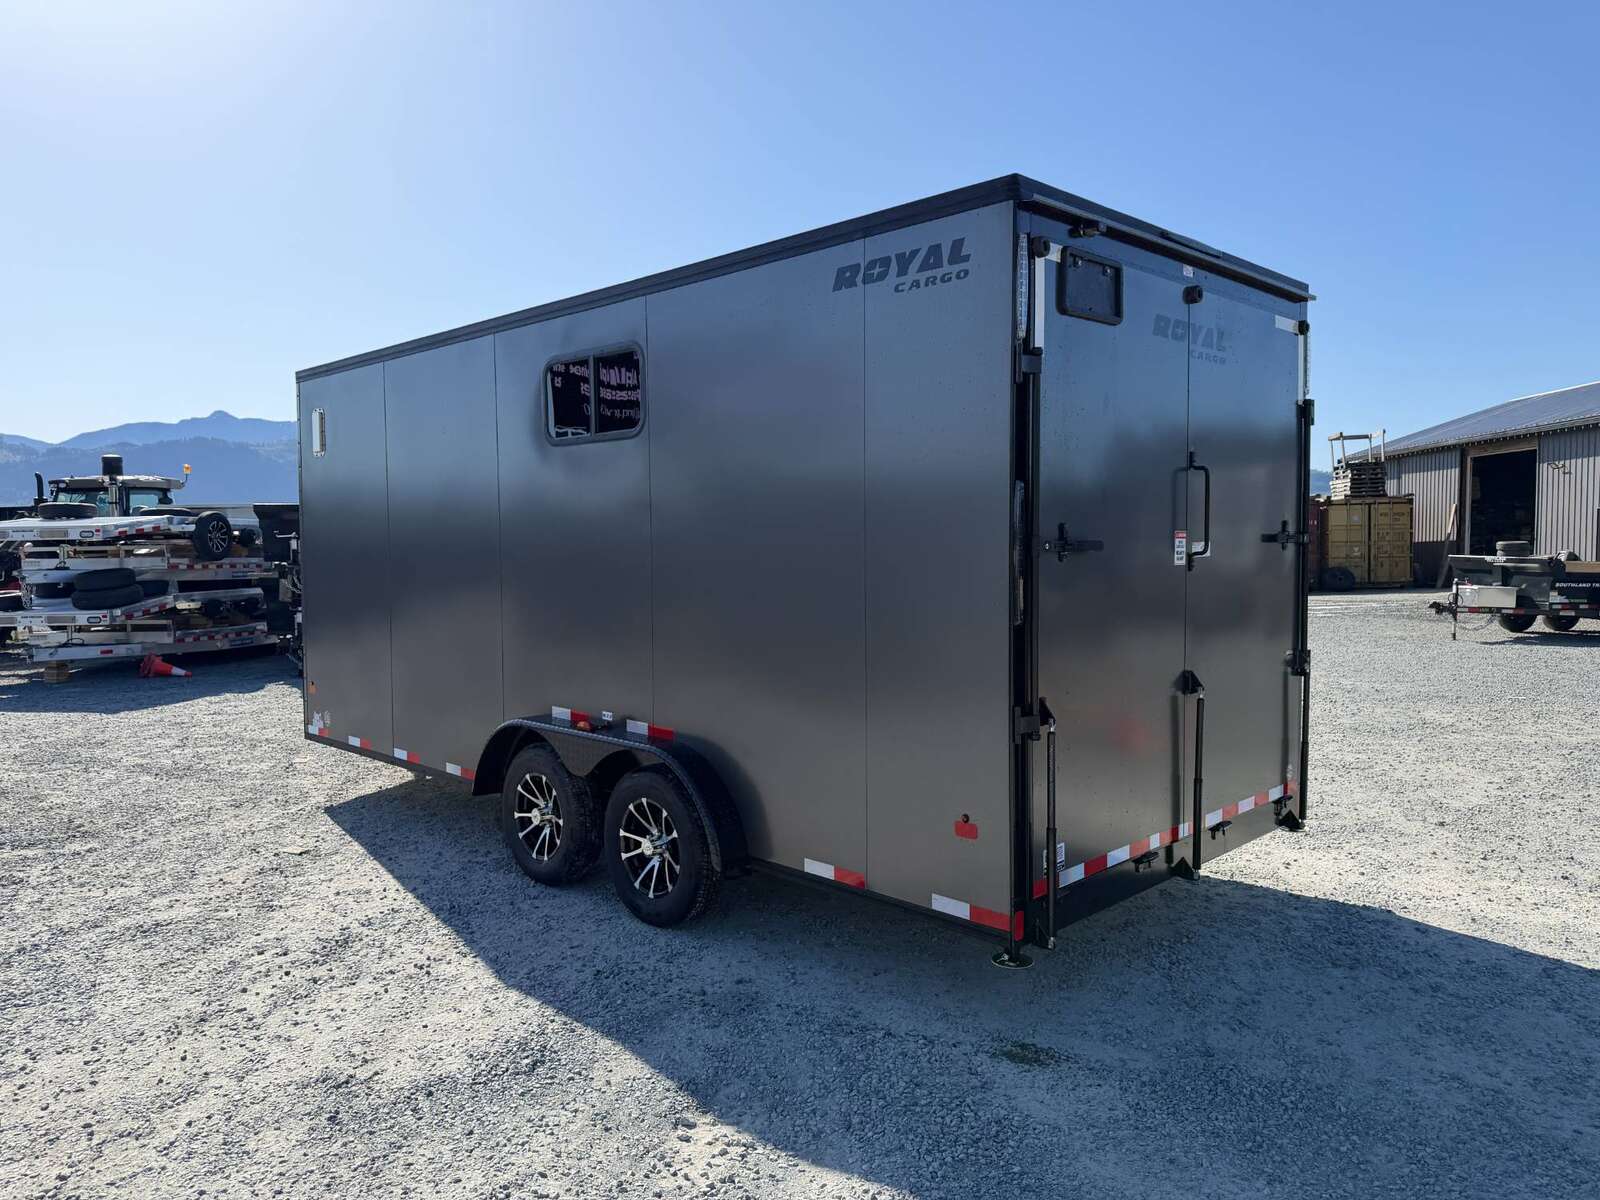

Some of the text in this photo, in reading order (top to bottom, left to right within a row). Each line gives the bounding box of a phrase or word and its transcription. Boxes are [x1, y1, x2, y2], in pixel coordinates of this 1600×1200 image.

[832, 237, 972, 292] ROYAL
[894, 268, 970, 293] CARGO
[1152, 313, 1228, 353] ROYAL
